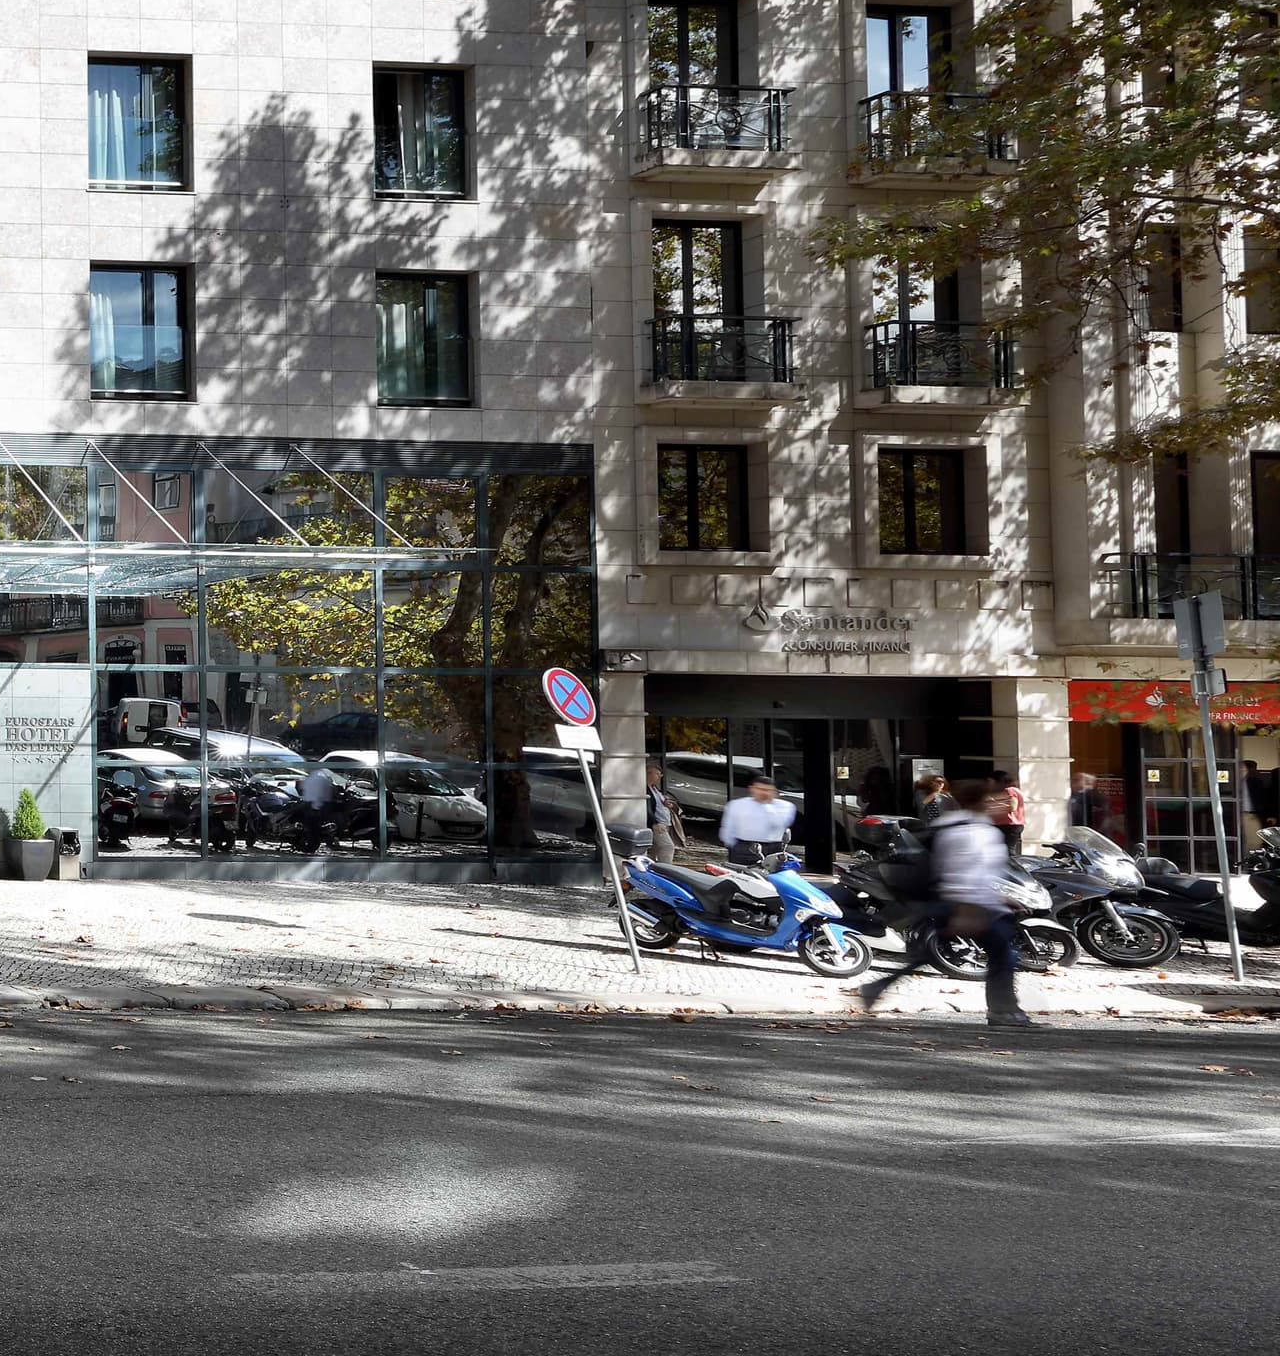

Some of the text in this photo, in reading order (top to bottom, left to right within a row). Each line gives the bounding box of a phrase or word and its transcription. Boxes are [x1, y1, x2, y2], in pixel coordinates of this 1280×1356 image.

[781, 609, 915, 632] Santander
[783, 641, 857, 652] CONSUMER
[5, 717, 75, 727] EUROSTARS
[5, 727, 76, 742] HOTEL
[5, 743, 75, 753] DAS LETRAS
